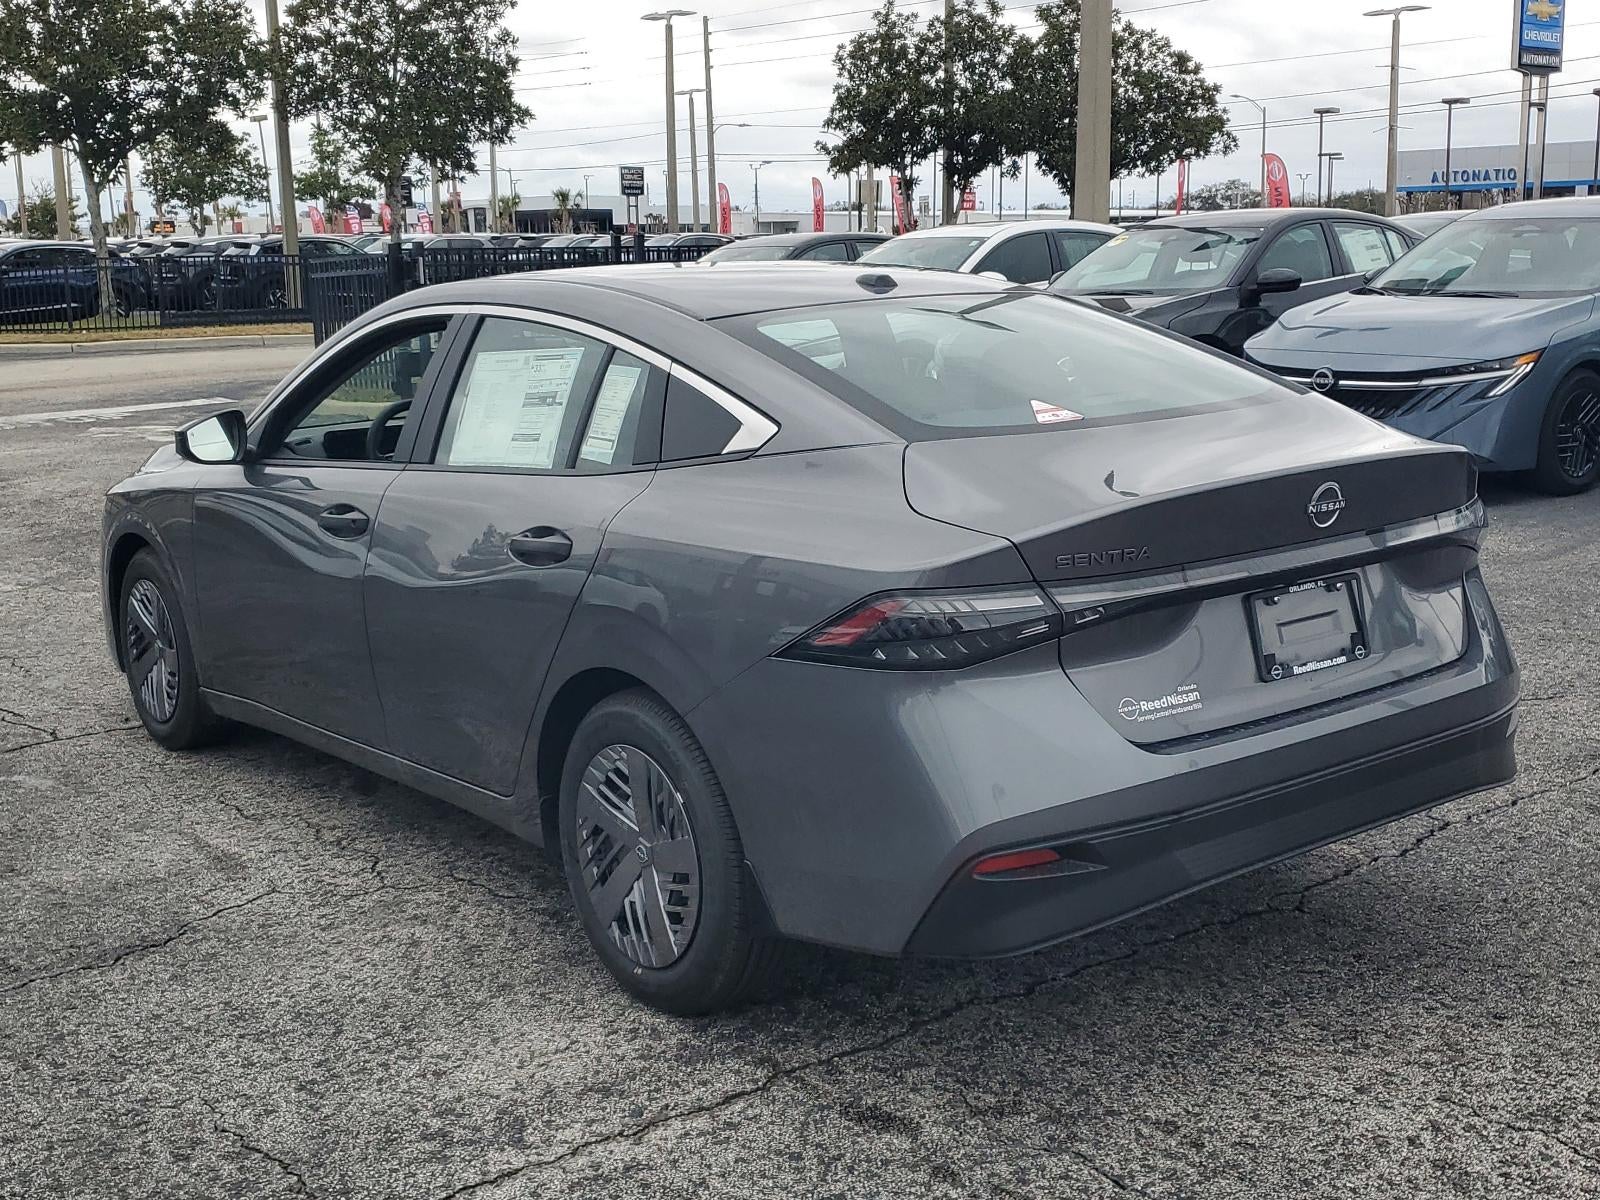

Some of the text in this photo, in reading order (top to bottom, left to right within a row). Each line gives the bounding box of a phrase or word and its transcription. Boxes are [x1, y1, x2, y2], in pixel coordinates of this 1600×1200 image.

[1524, 30, 1560, 43] CHEVROLET
[1522, 53, 1560, 66] AUTONATION
[1431, 168, 1517, 184] AUTONATIO
[1308, 499, 1345, 514] NISSAN
[1055, 546, 1149, 568] SENTRA
[1293, 656, 1346, 674] ReedNissan.com
[1177, 684, 1197, 692] Orlando
